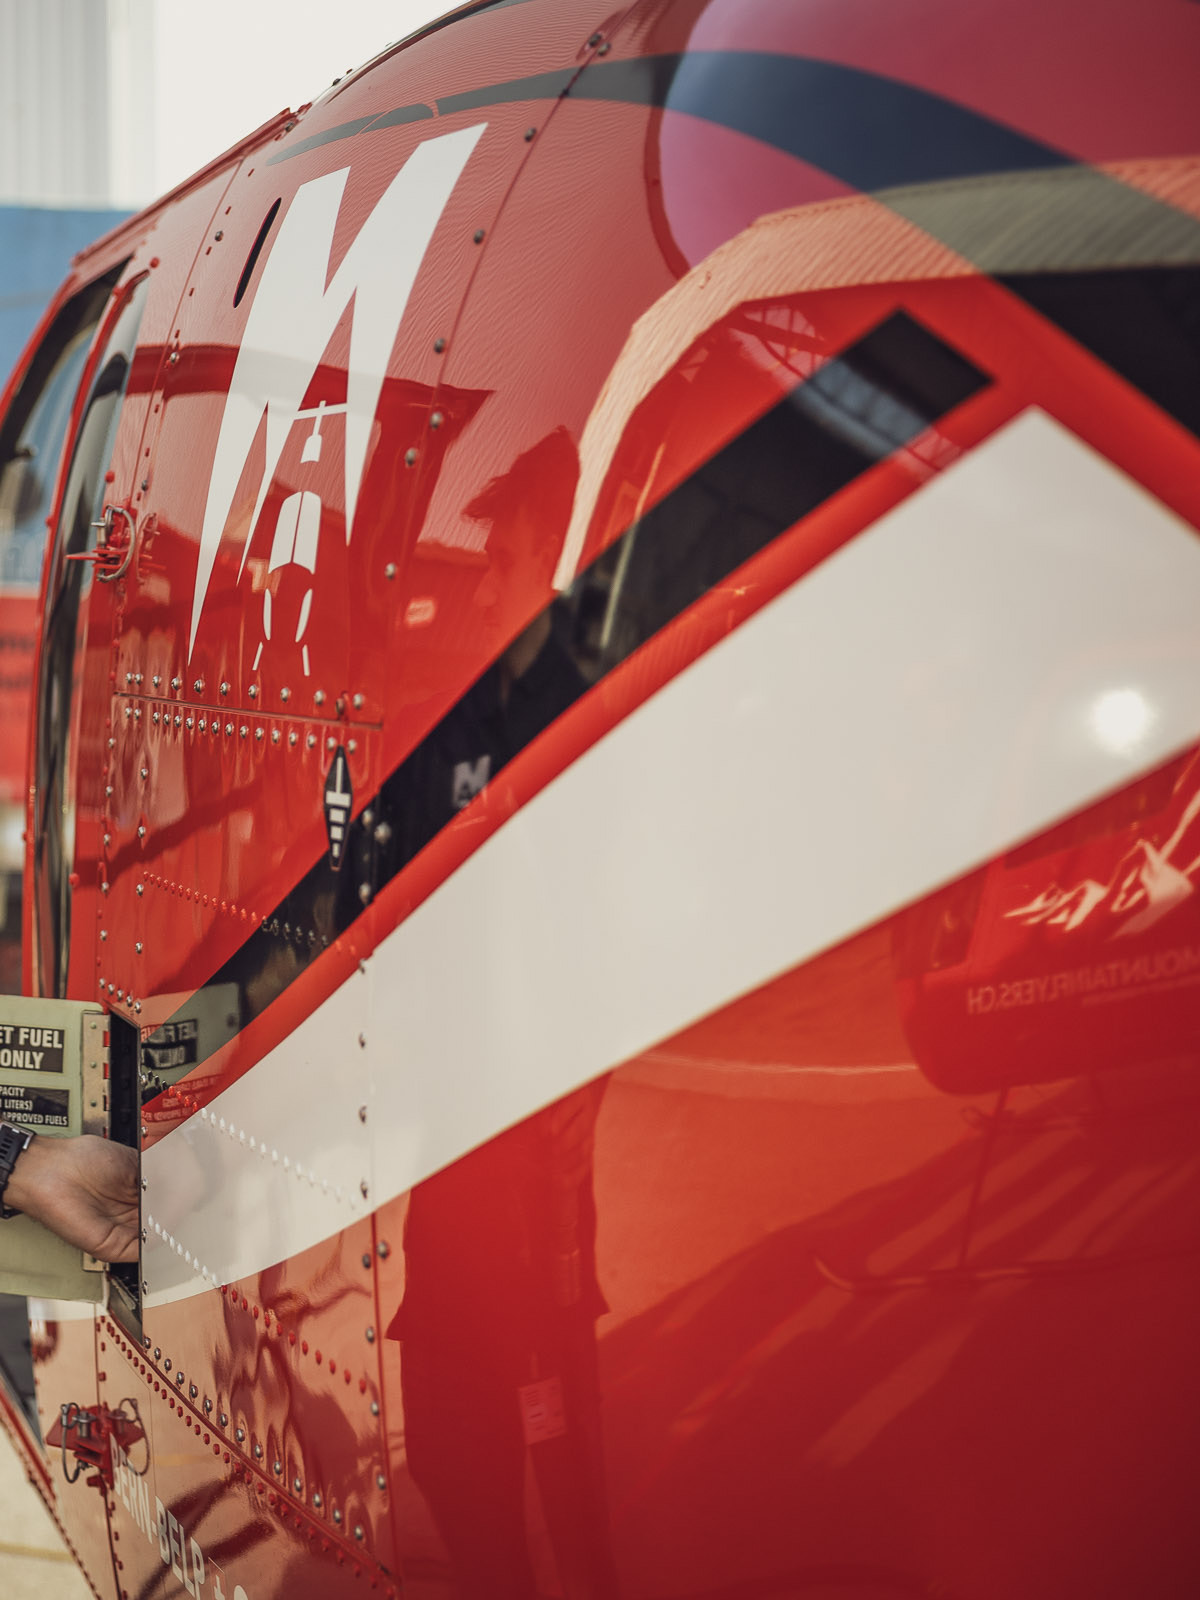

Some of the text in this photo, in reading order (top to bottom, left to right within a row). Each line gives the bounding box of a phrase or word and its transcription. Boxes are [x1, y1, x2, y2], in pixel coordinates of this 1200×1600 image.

[19, 1028, 62, 1048] FUEL
[0, 1049, 44, 1069] ONLY
[45, 1115, 67, 1126] FUELS
